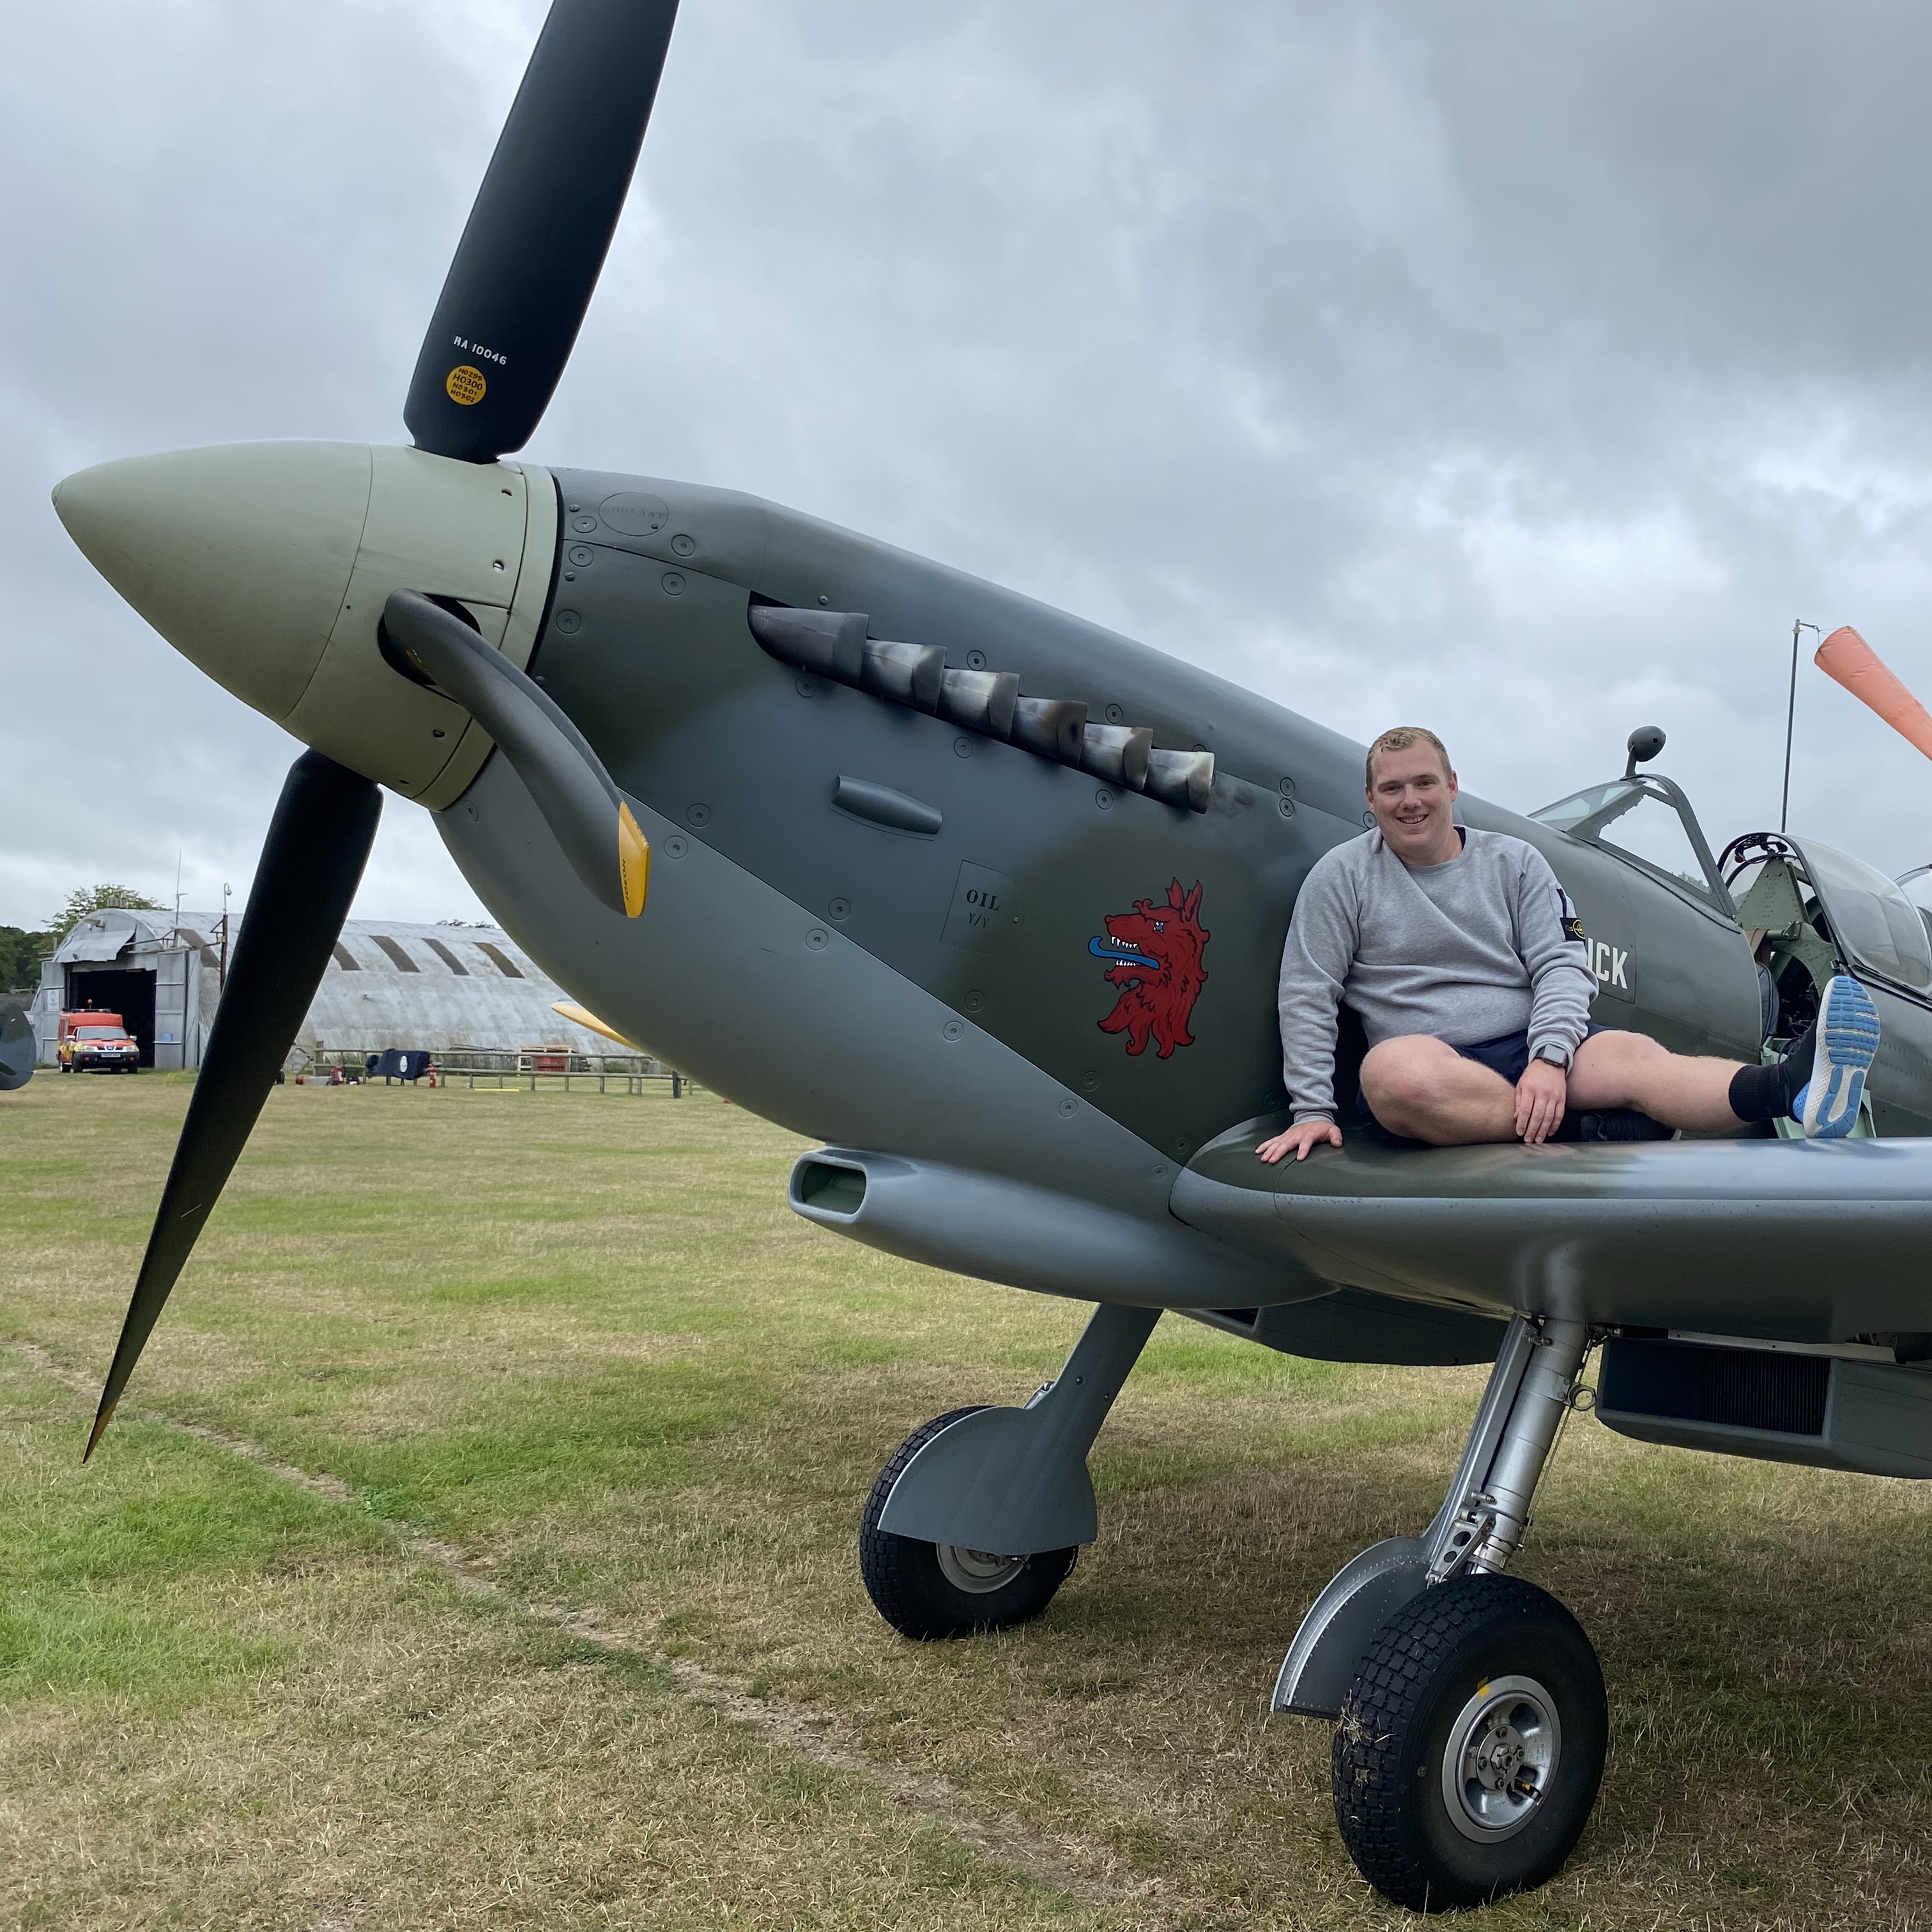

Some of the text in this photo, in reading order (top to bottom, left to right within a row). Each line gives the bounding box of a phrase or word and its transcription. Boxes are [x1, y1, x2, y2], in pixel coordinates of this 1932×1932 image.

[453, 335, 507, 365] RA 10046
[603, 505, 668, 519] COOLANT
[966, 889, 1001, 911] OIL
